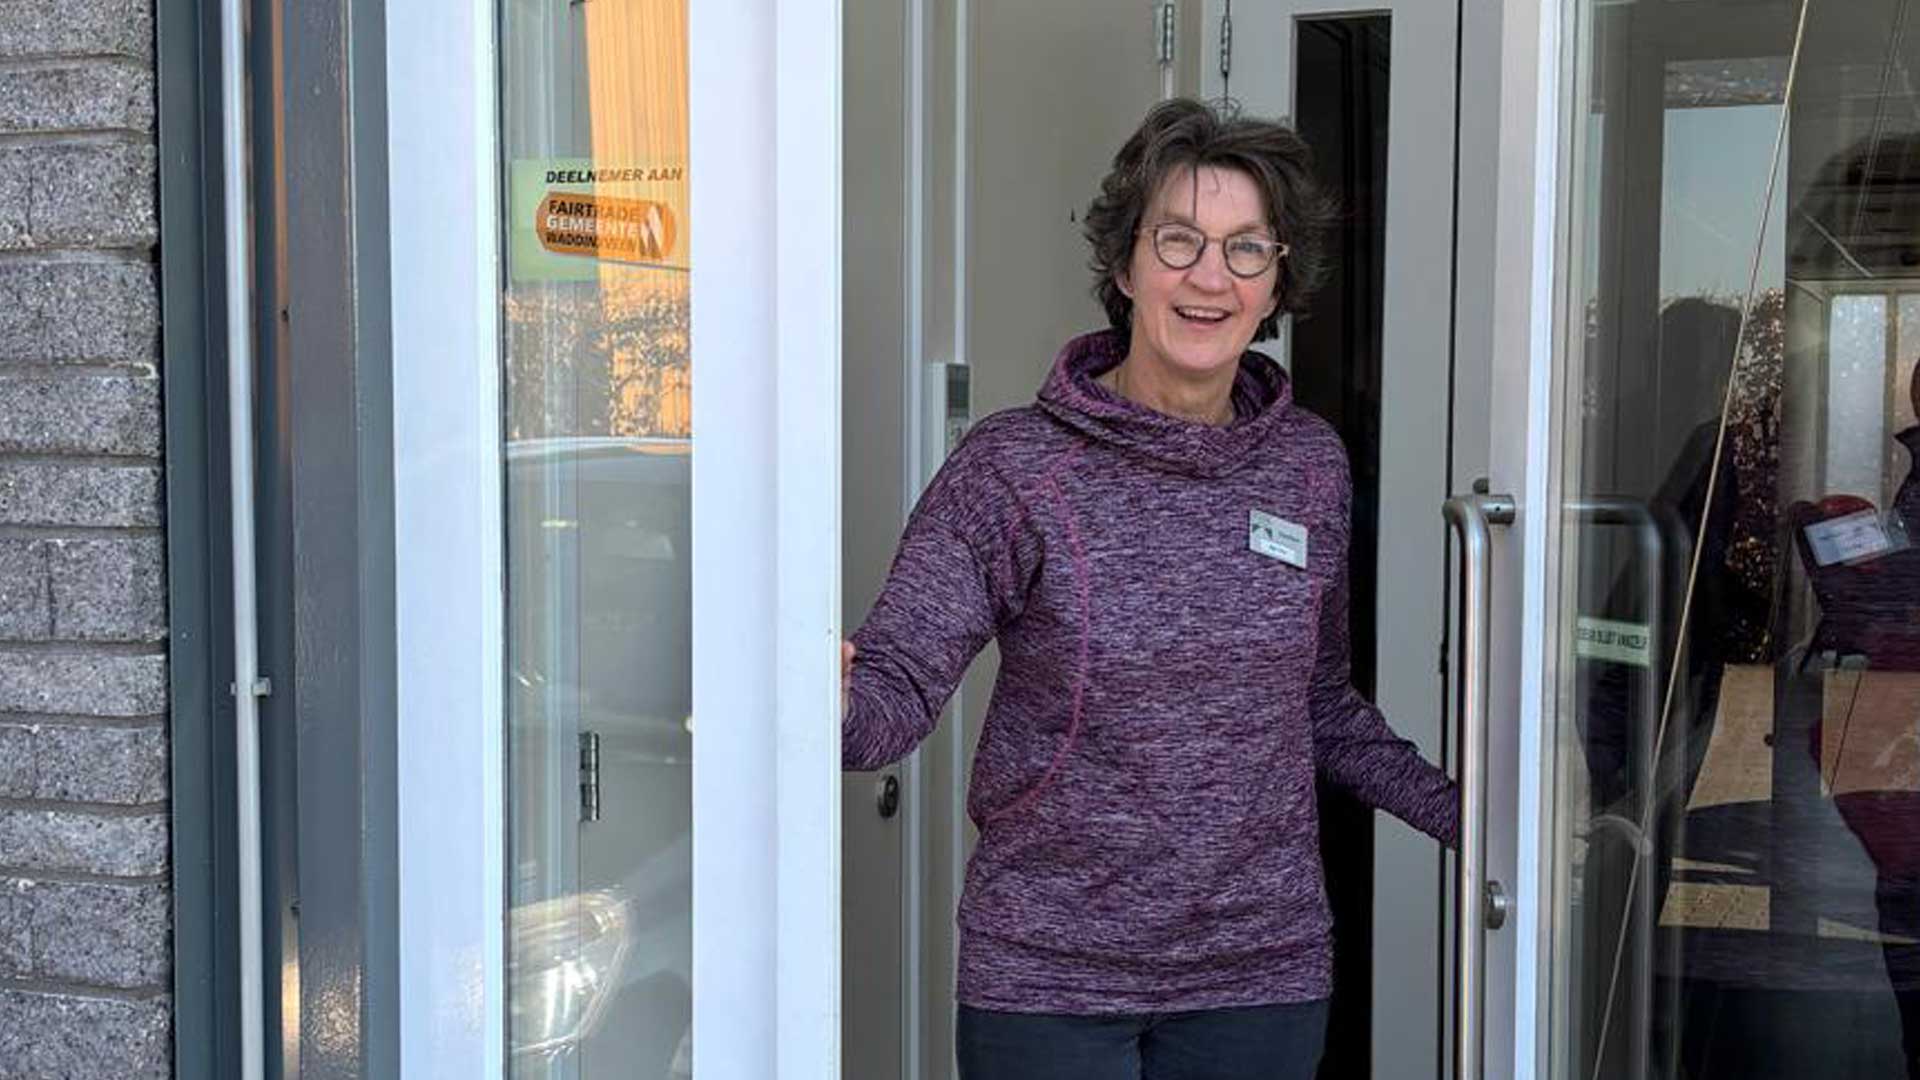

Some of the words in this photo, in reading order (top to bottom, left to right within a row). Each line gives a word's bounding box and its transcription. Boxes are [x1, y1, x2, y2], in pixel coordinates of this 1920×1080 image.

[546, 169, 644, 183] DEELNEMER
[647, 167, 682, 181] AAN
[549, 200, 640, 222] FAIRTRADE
[546, 215, 640, 236] GEMEENTE
